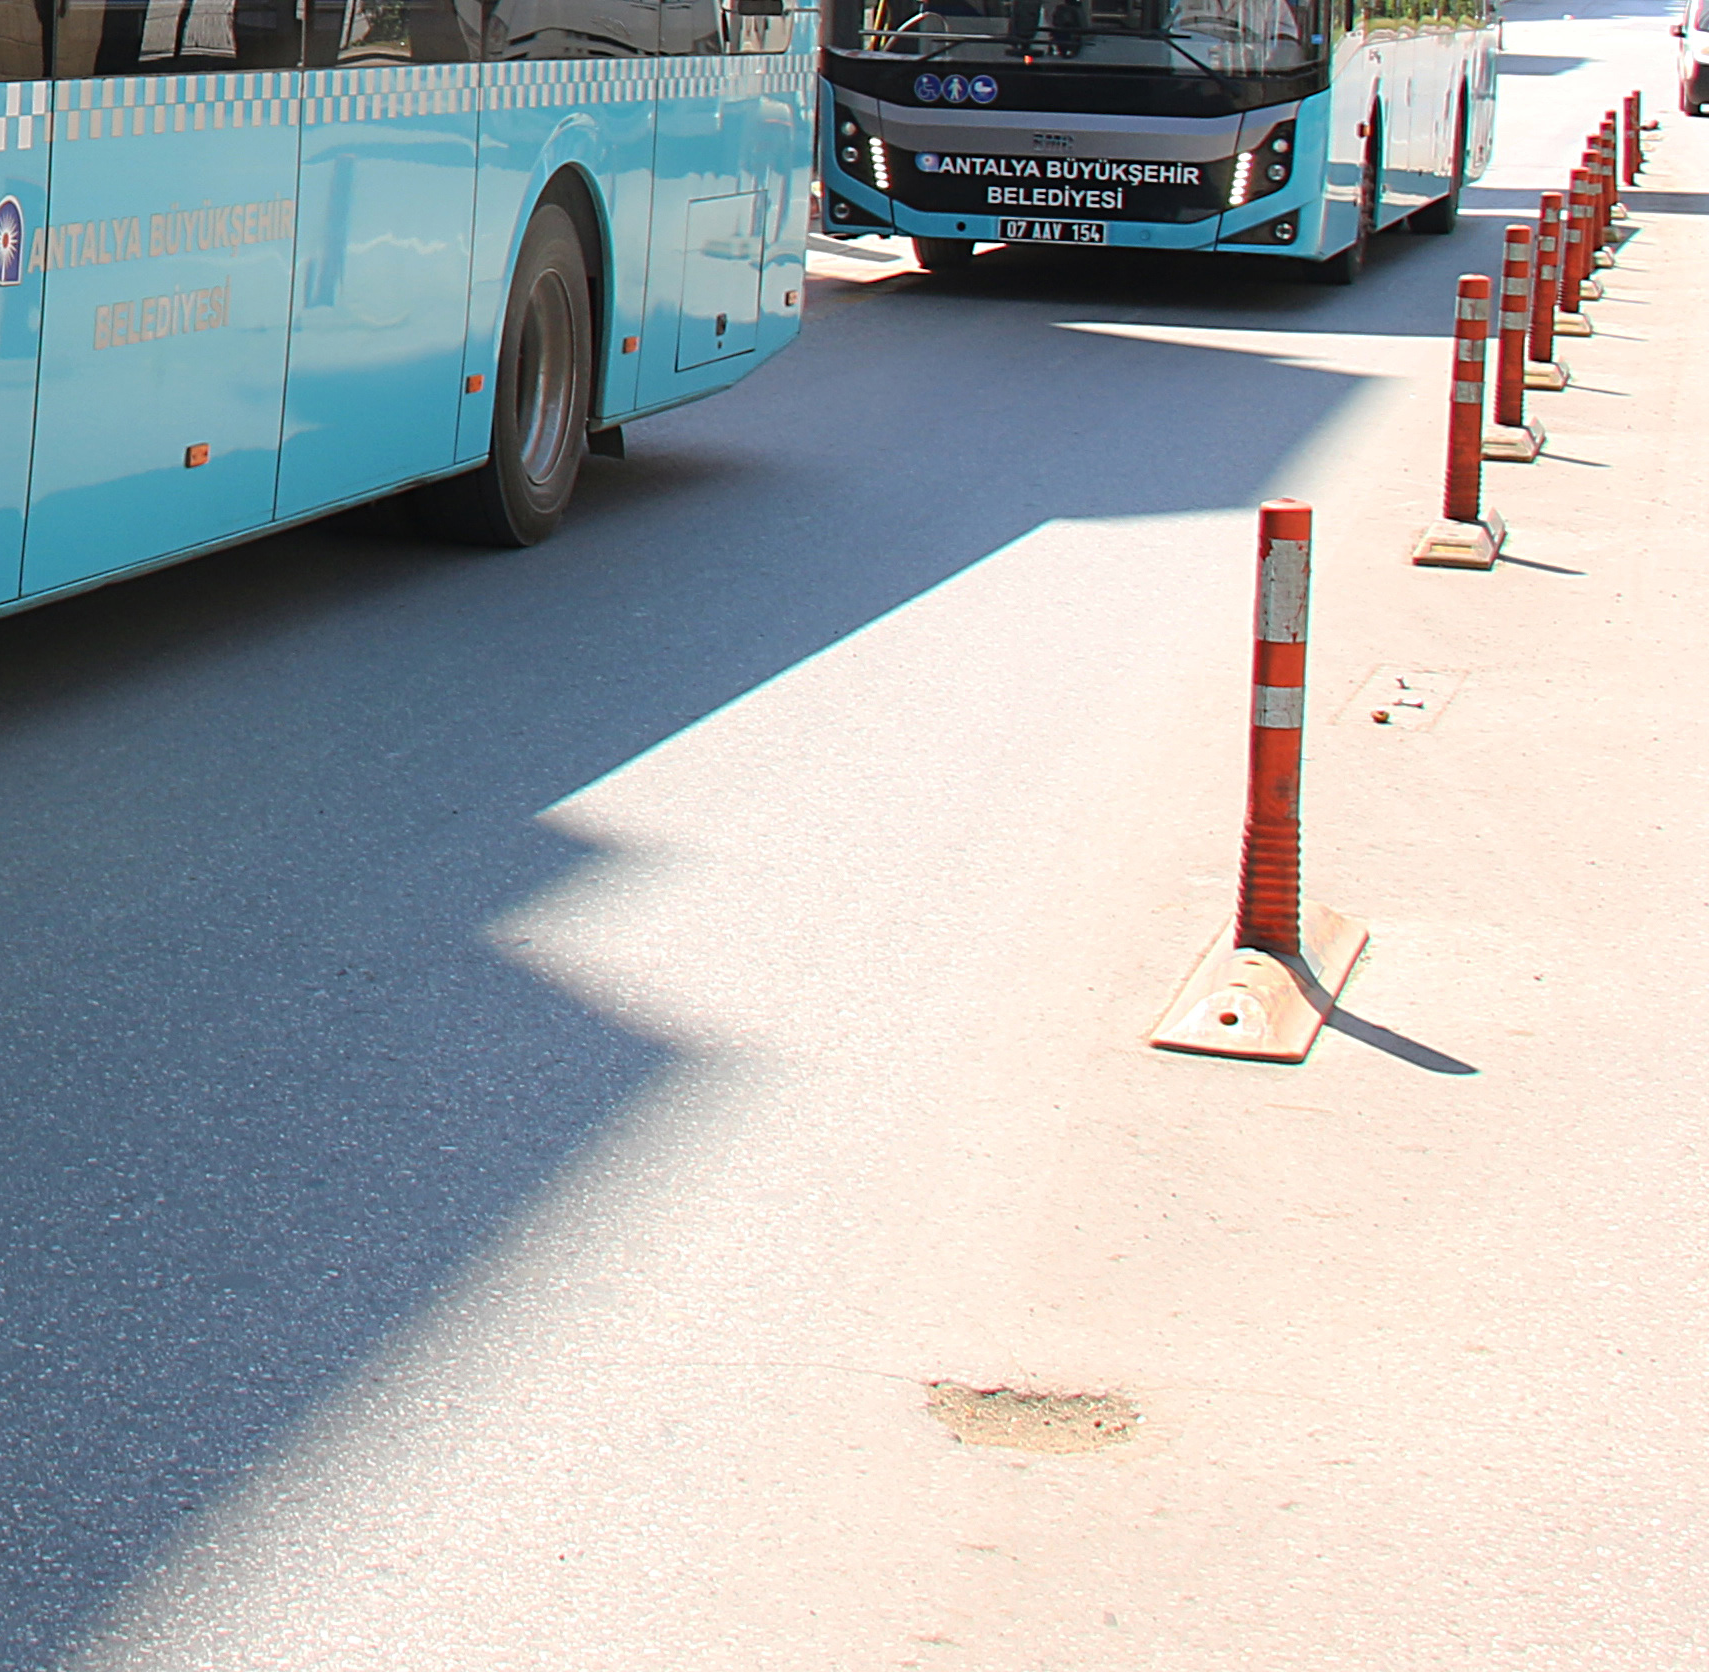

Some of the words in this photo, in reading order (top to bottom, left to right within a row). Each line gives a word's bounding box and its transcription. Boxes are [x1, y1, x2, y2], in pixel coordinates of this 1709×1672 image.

[938, 156, 1041, 178] ANTALYA
[1046, 157, 1201, 186] BÜYÜKŞEHİR
[987, 185, 1123, 209] BELEDİYESİ
[27, 215, 141, 274] ANTALYA
[148, 191, 295, 258] BÜYÜKŞEHİR
[1006, 220, 1027, 238] 07
[1032, 221, 1063, 240] AAV
[1071, 224, 1101, 242] 154
[92, 275, 231, 350] BELEDİYESİ
